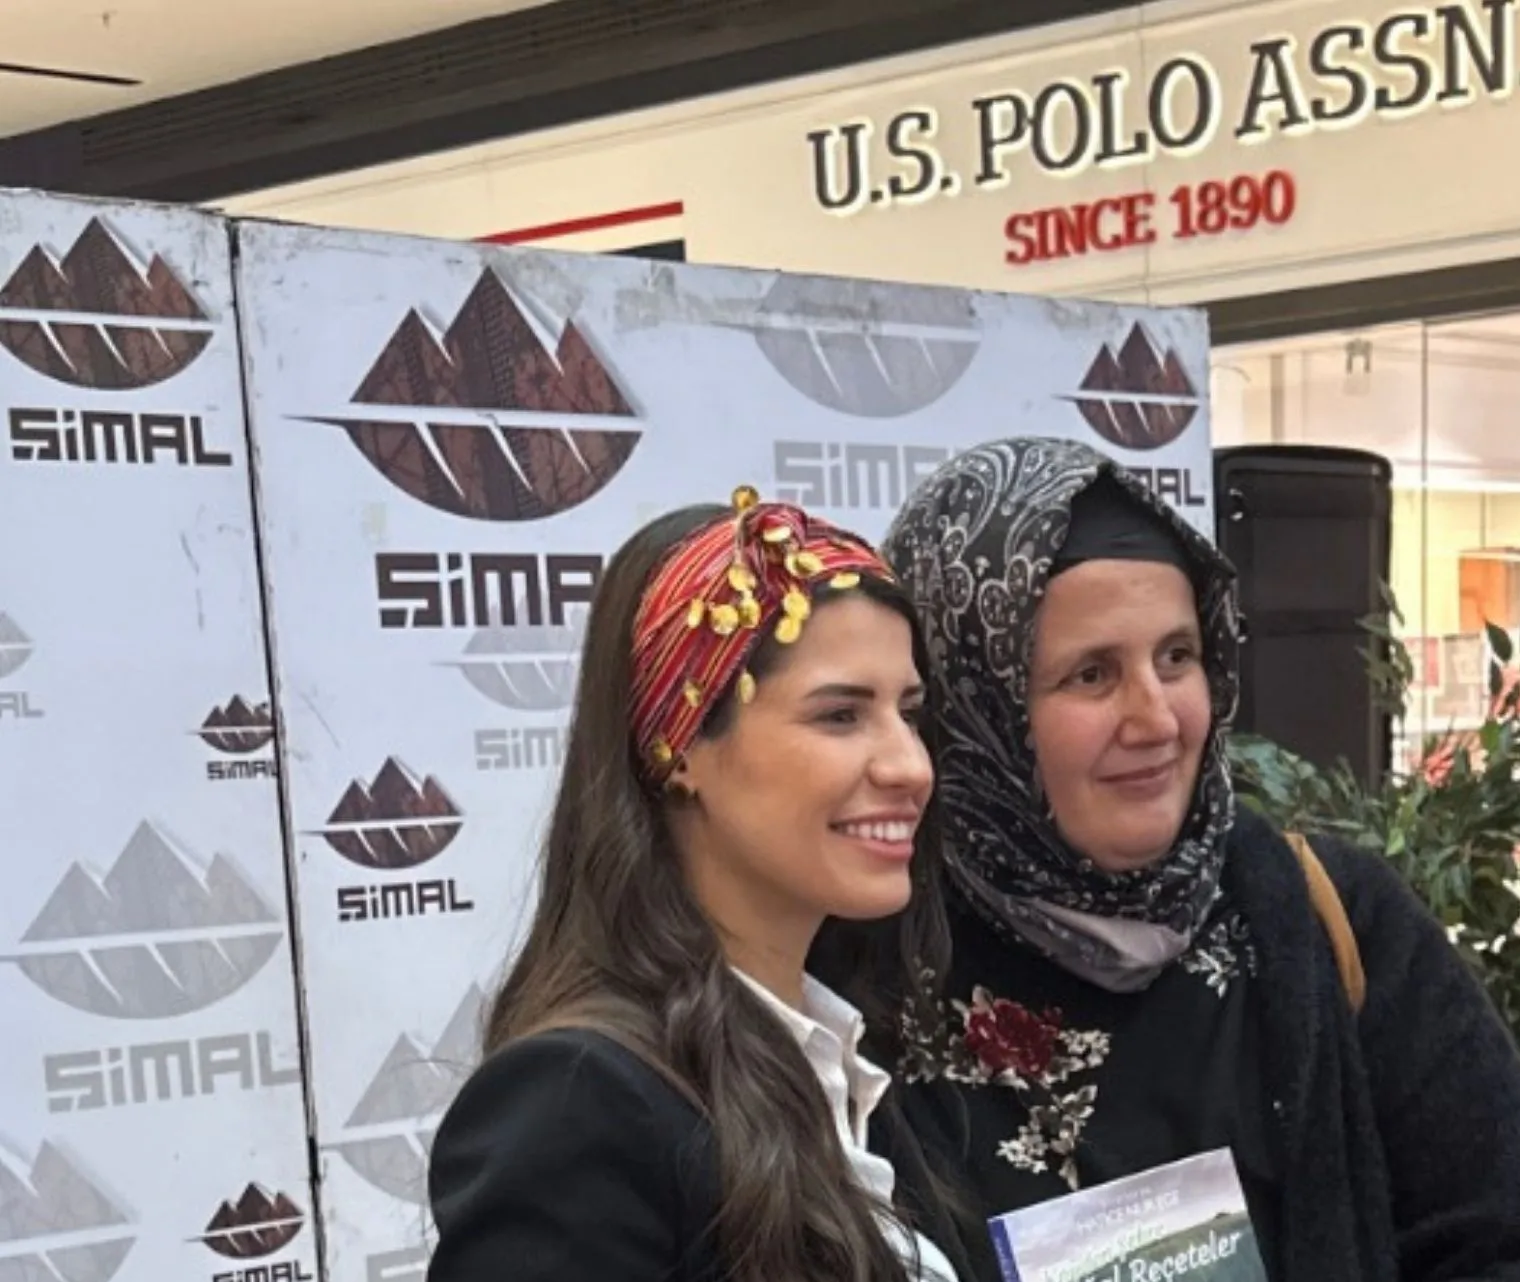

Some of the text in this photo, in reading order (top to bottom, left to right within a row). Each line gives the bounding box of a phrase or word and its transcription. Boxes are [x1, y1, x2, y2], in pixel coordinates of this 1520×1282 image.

[806, 110, 953, 209] U.S.
[972, 56, 1213, 186] POLO
[1004, 169, 1297, 267] SINCE 1890
